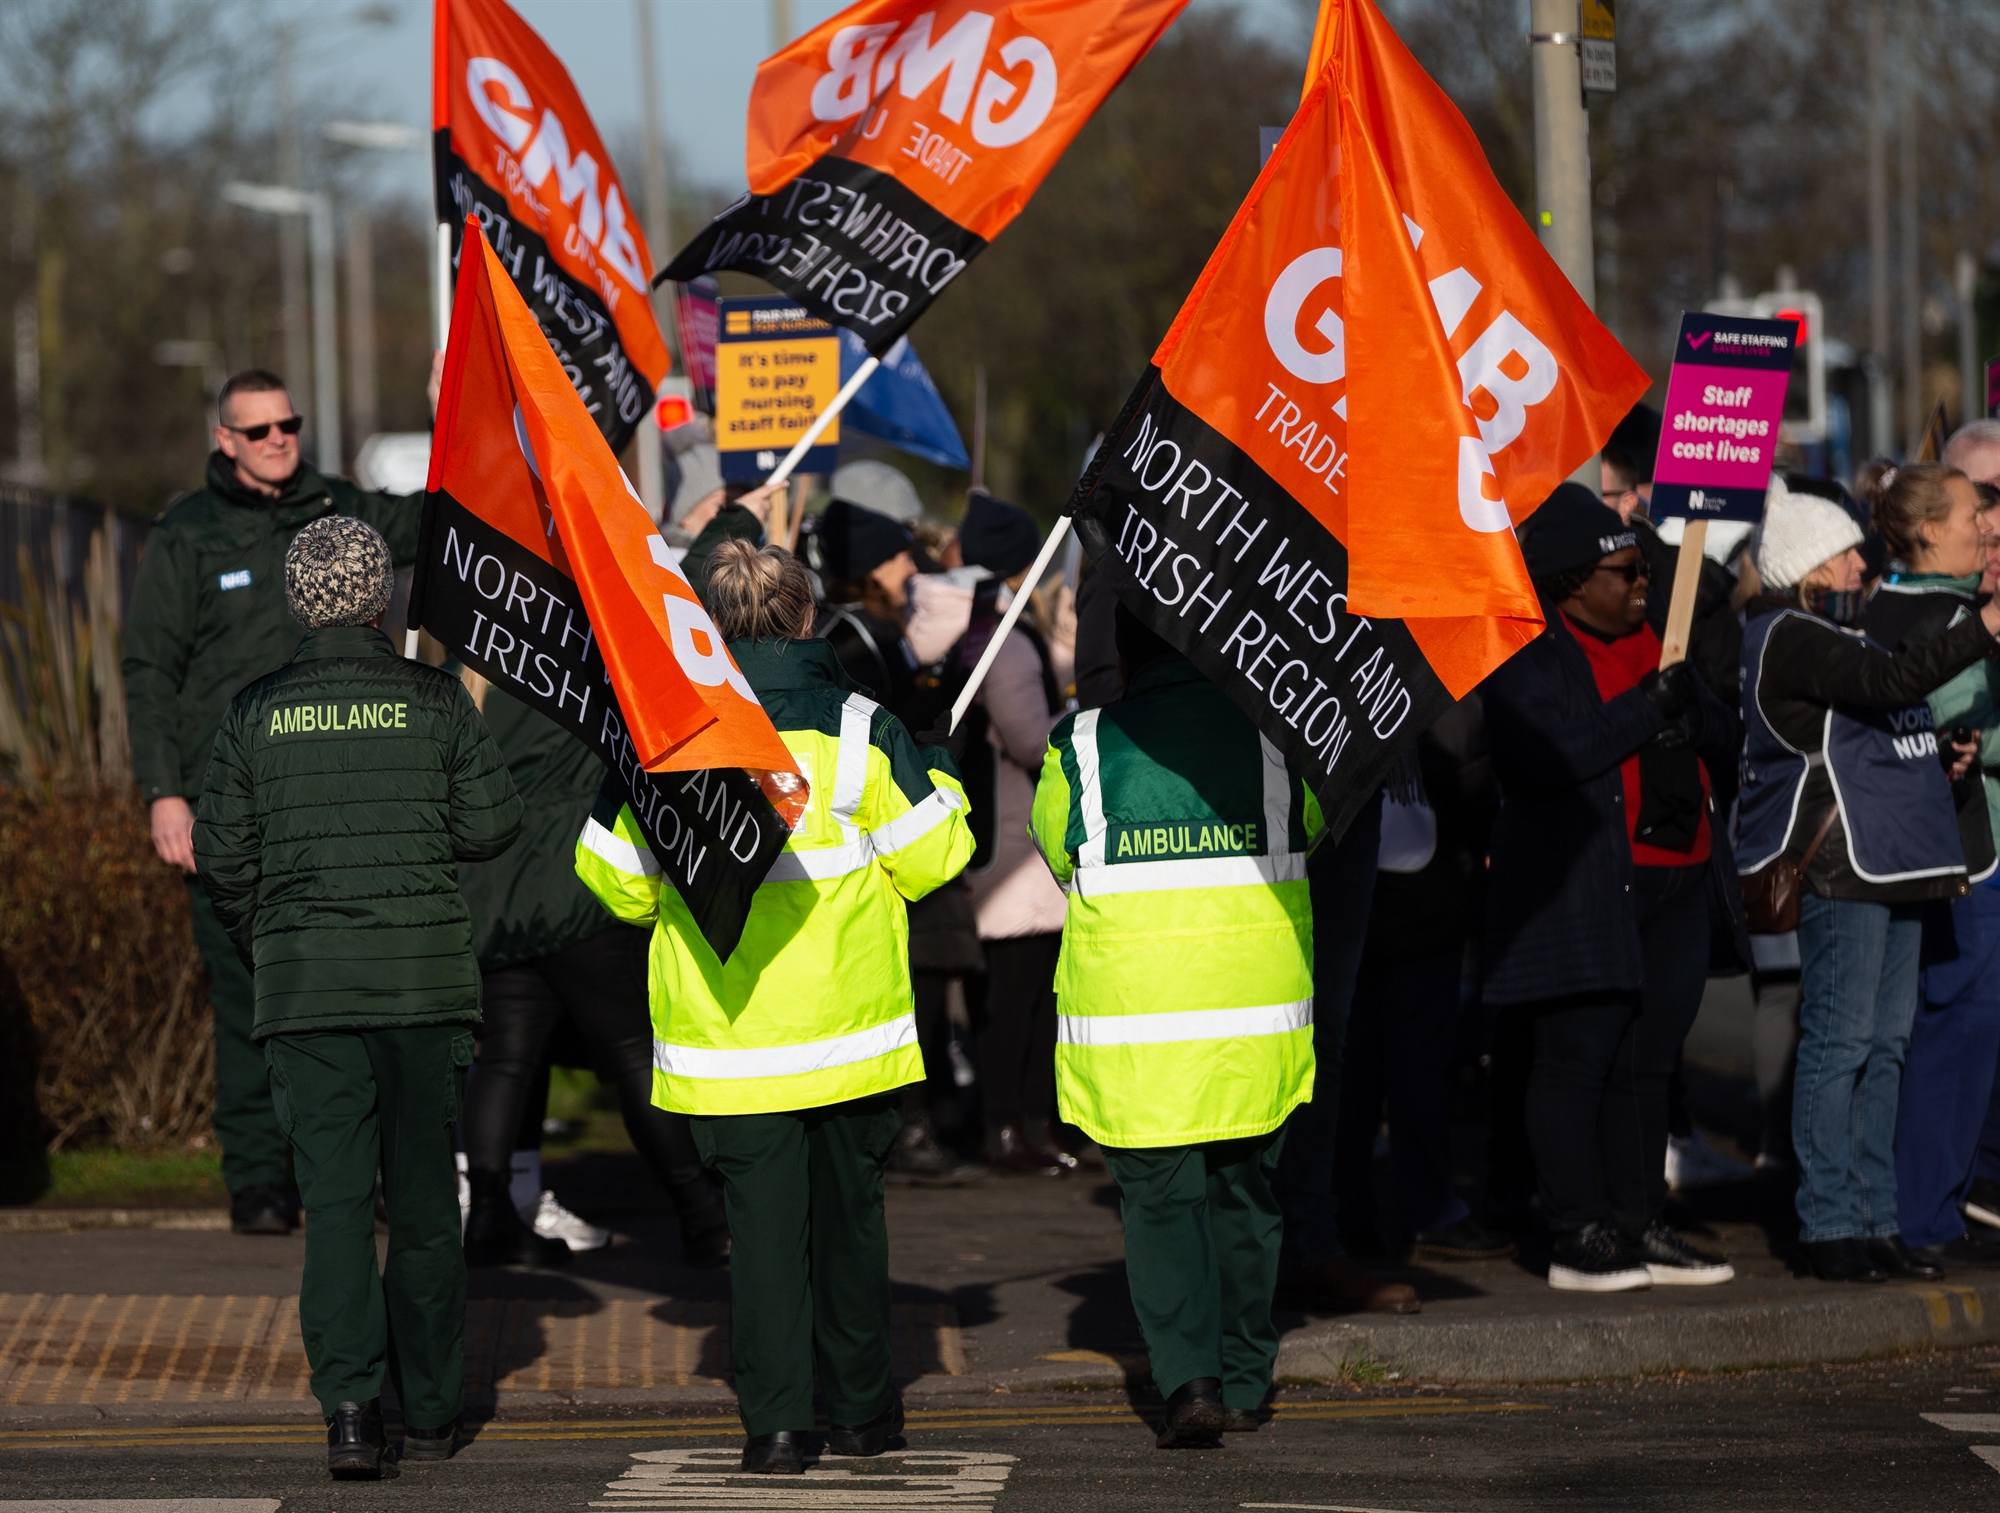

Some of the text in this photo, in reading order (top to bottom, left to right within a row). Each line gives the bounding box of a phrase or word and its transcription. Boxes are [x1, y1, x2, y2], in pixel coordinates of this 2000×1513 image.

[533, 256, 609, 346] WEST
[593, 342, 642, 424] AND
[1714, 331, 1788, 349] SAFE STAFFING
[773, 349, 817, 366] time
[749, 373, 808, 390] to pay
[1702, 384, 1752, 407] Staff
[742, 393, 814, 410] nursing
[730, 415, 773, 432] staff
[1254, 382, 1348, 495] TRADE
[1673, 410, 1769, 440] shortages
[1672, 439, 1760, 464] cost lives
[220, 570, 251, 590] NHS
[1124, 413, 1411, 740] NORTH WEST AND
[443, 526, 592, 662] NORTH
[1116, 503, 1352, 776] IRISH REGION
[270, 703, 407, 737] AMBULANCE
[464, 609, 591, 723] IRISH
[601, 707, 706, 886] REGION
[1892, 732, 1939, 760] NUR
[680, 769, 760, 863] AND
[1117, 824, 1257, 857] AMBULANCE
